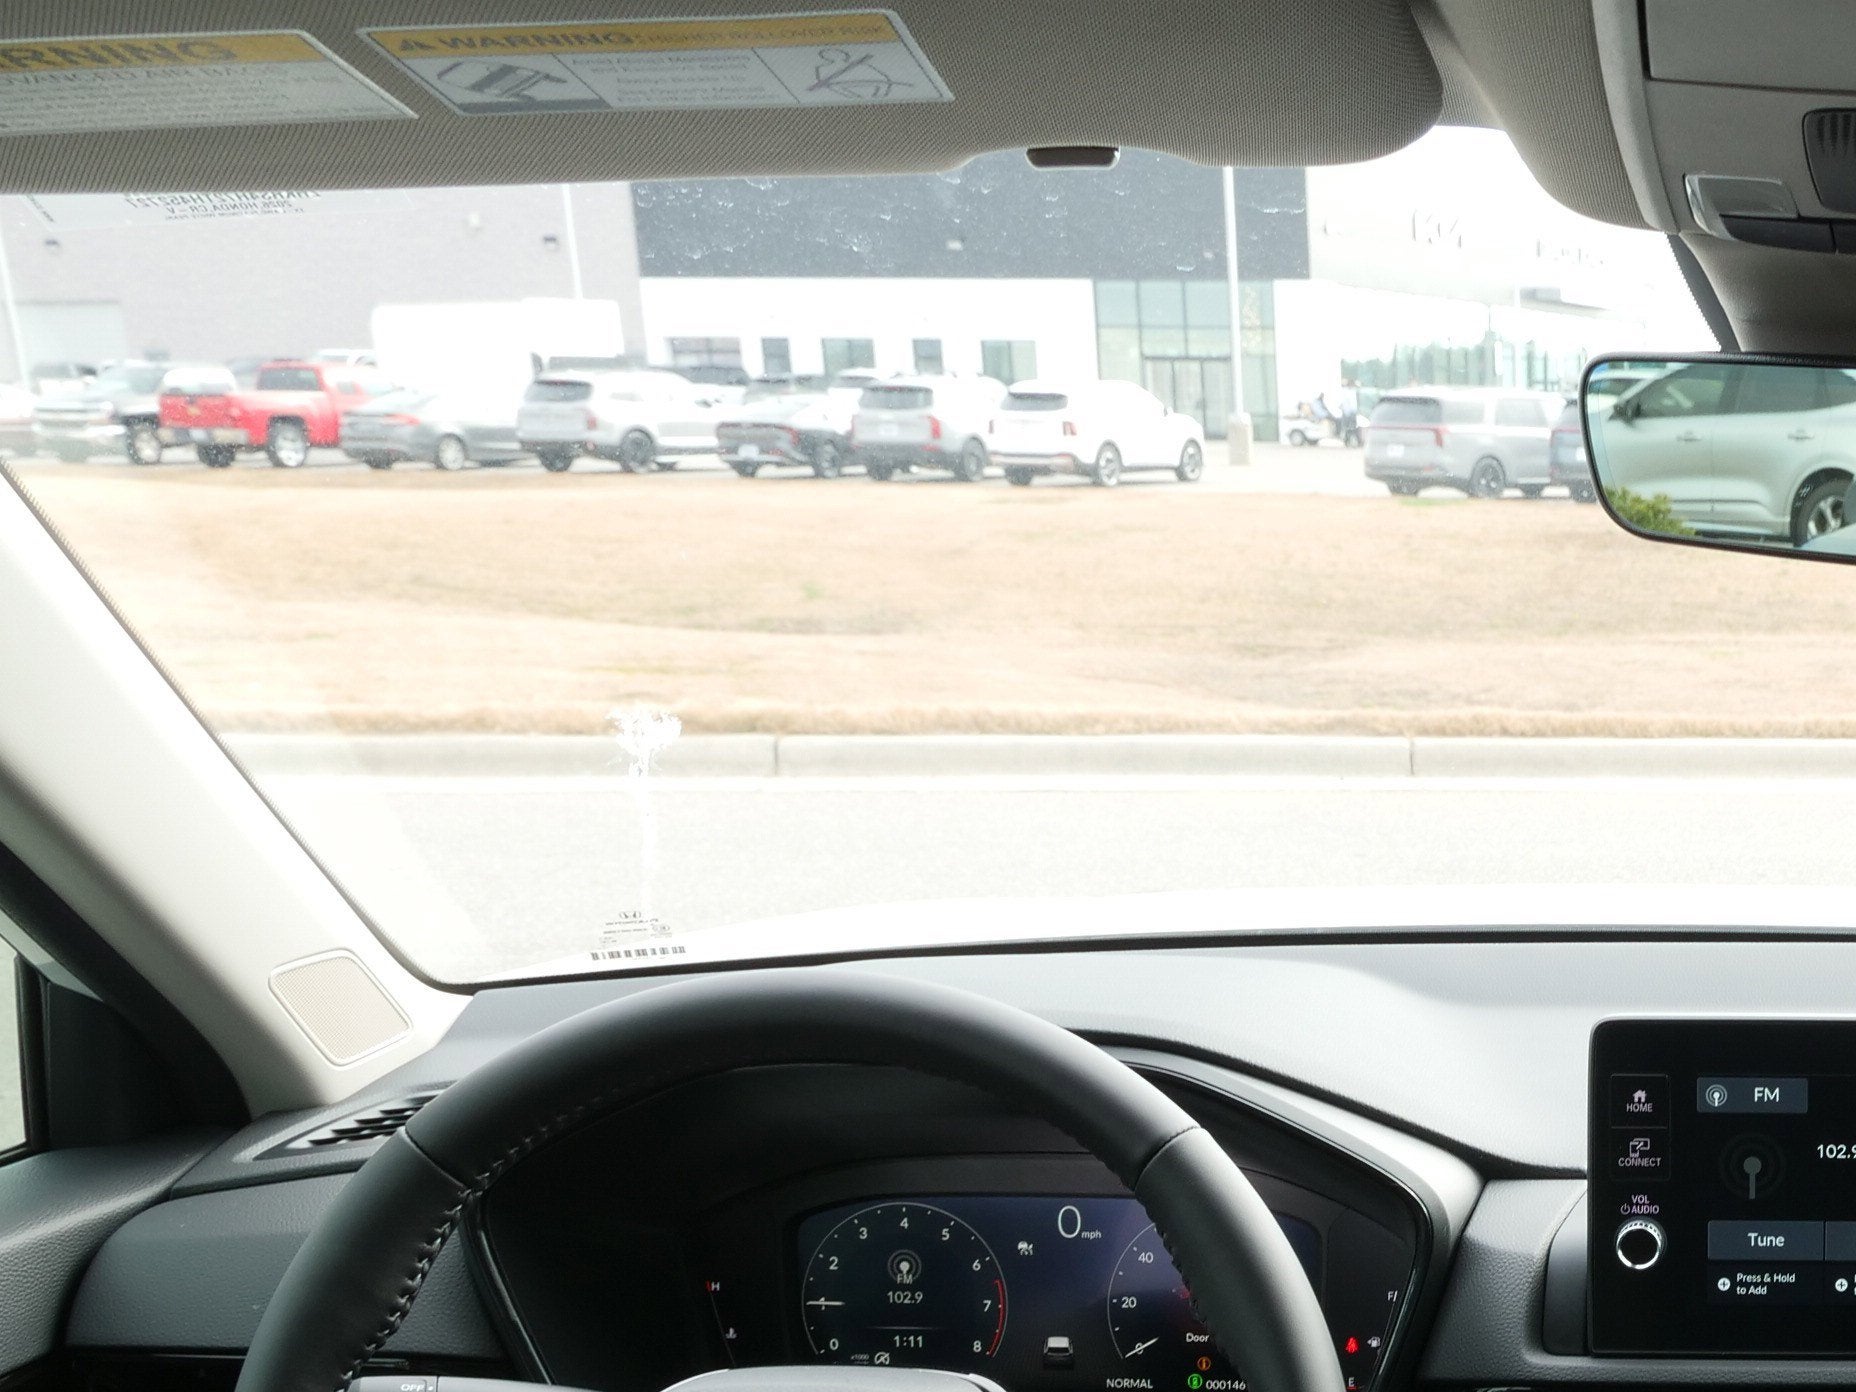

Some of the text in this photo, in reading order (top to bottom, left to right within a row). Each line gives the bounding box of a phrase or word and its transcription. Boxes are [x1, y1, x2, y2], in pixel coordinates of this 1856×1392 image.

[0, 40, 237, 72] RNING
[1753, 1087, 1780, 1103] FM
[1625, 1102, 1653, 1113] HOME
[1618, 1156, 1661, 1168] CONNECT
[1631, 1195, 1650, 1205] VOL
[1631, 1204, 1659, 1215] AUDIO
[900, 1218, 908, 1228] 4
[1058, 1206, 1101, 1240] 0 mph
[859, 1228, 867, 1239] 3
[942, 1229, 949, 1240] 5
[1748, 1232, 1785, 1248] Tune
[1138, 1252, 1153, 1263] 40
[829, 1258, 838, 1269] 2
[972, 1260, 981, 1271] 6
[897, 1274, 913, 1284] FM
[1736, 1273, 1795, 1283] Press & Hold
[1736, 1285, 1767, 1295] to Add
[888, 1292, 922, 1304] 102.9
[1122, 1297, 1137, 1308] 20
[983, 1301, 991, 1312] 7
[894, 1335, 923, 1348] 1:11
[1186, 1333, 1209, 1342] Door
[830, 1339, 839, 1350] 0
[973, 1341, 981, 1352] 8
[401, 1384, 424, 1392] OFF
[1107, 1378, 1153, 1389] NORMAL
[1206, 1380, 1246, 1390] 000146
